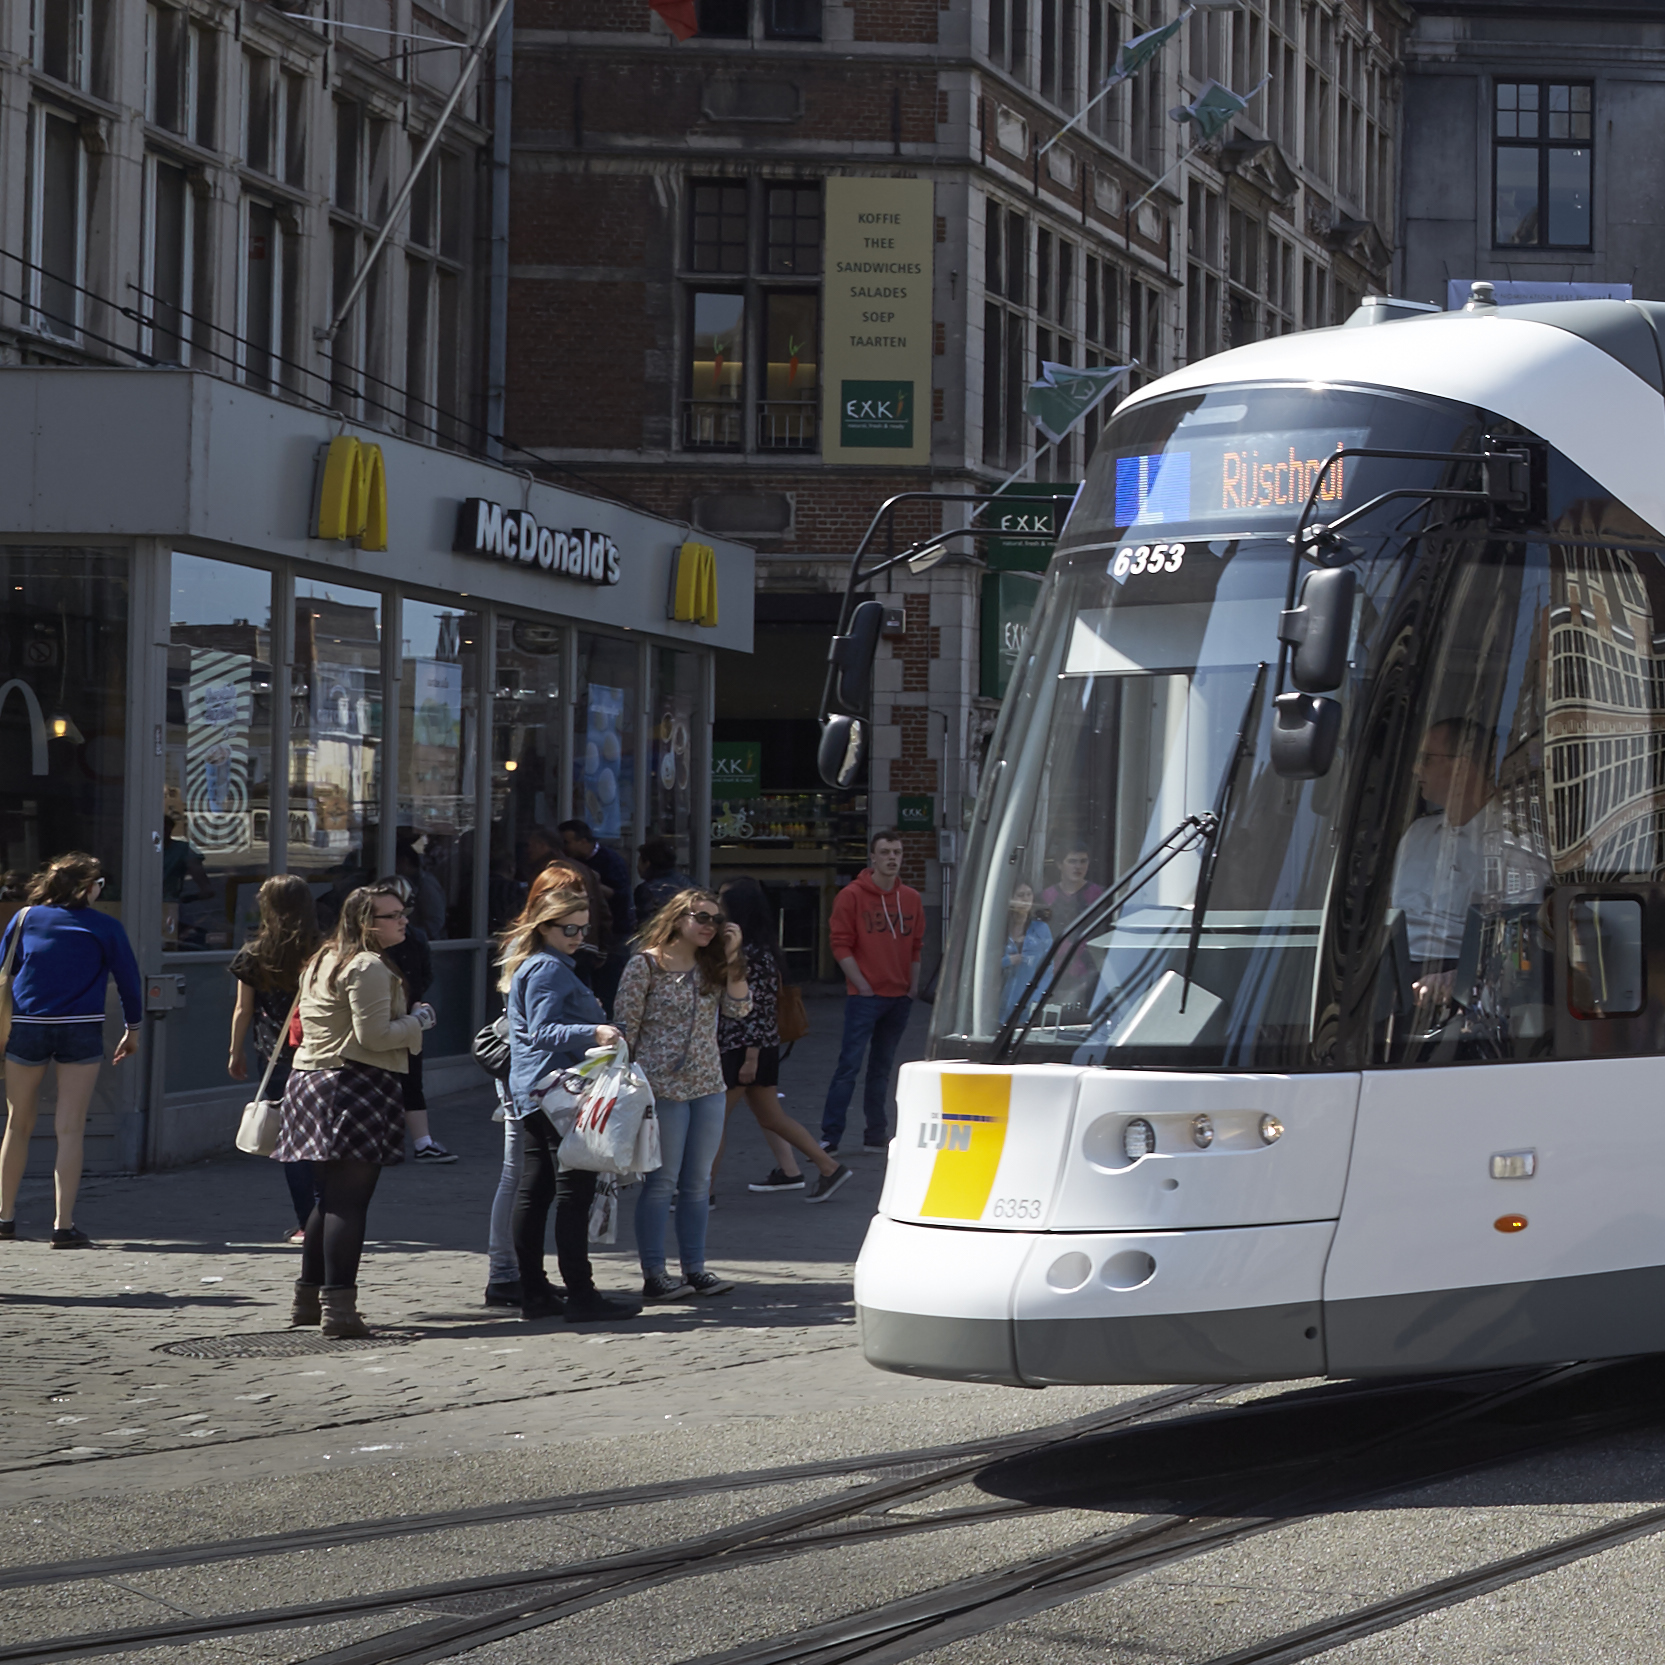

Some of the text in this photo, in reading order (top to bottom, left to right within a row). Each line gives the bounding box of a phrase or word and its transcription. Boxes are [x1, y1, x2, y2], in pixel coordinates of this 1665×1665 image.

[858, 213, 901, 224] KOFFIE
[863, 237, 895, 249] THEE
[836, 261, 922, 274] SANDWICHES
[850, 287, 907, 299] SALADES
[862, 311, 895, 322] SOEP
[850, 336, 907, 348] TAARTEN
[475, 499, 621, 584] McDonald's
[1113, 542, 1186, 577] 6353
[917, 1122, 973, 1152] LIJN
[993, 1198, 1042, 1219] 6353
